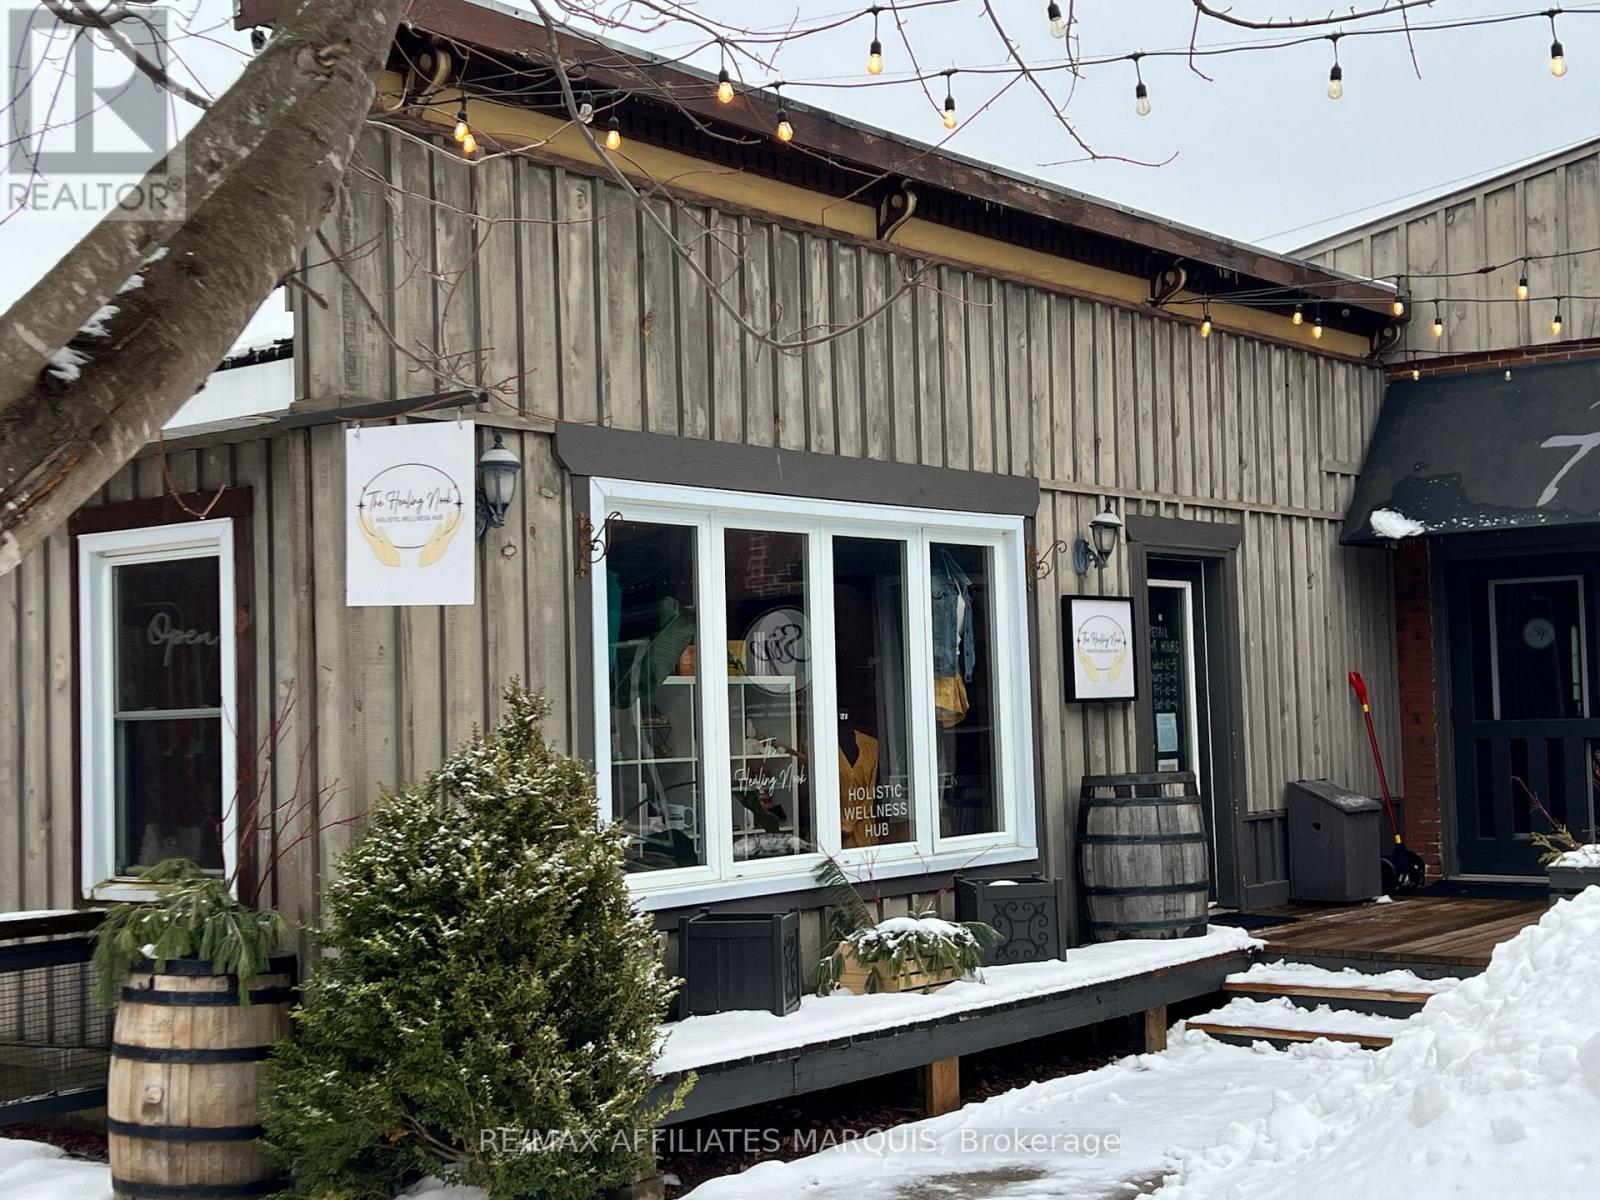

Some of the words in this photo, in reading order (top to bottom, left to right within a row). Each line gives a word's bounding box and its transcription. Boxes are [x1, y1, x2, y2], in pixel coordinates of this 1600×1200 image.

[365, 490, 384, 512] The
[385, 489, 424, 515] Healing
[147, 612, 220, 667] Open
[759, 736, 778, 763] The
[734, 765, 777, 798] Healing
[778, 763, 807, 792] Nook
[848, 784, 903, 801] HOLISTIC
[844, 802, 908, 821] WELLNESS
[864, 822, 889, 838] HUB
